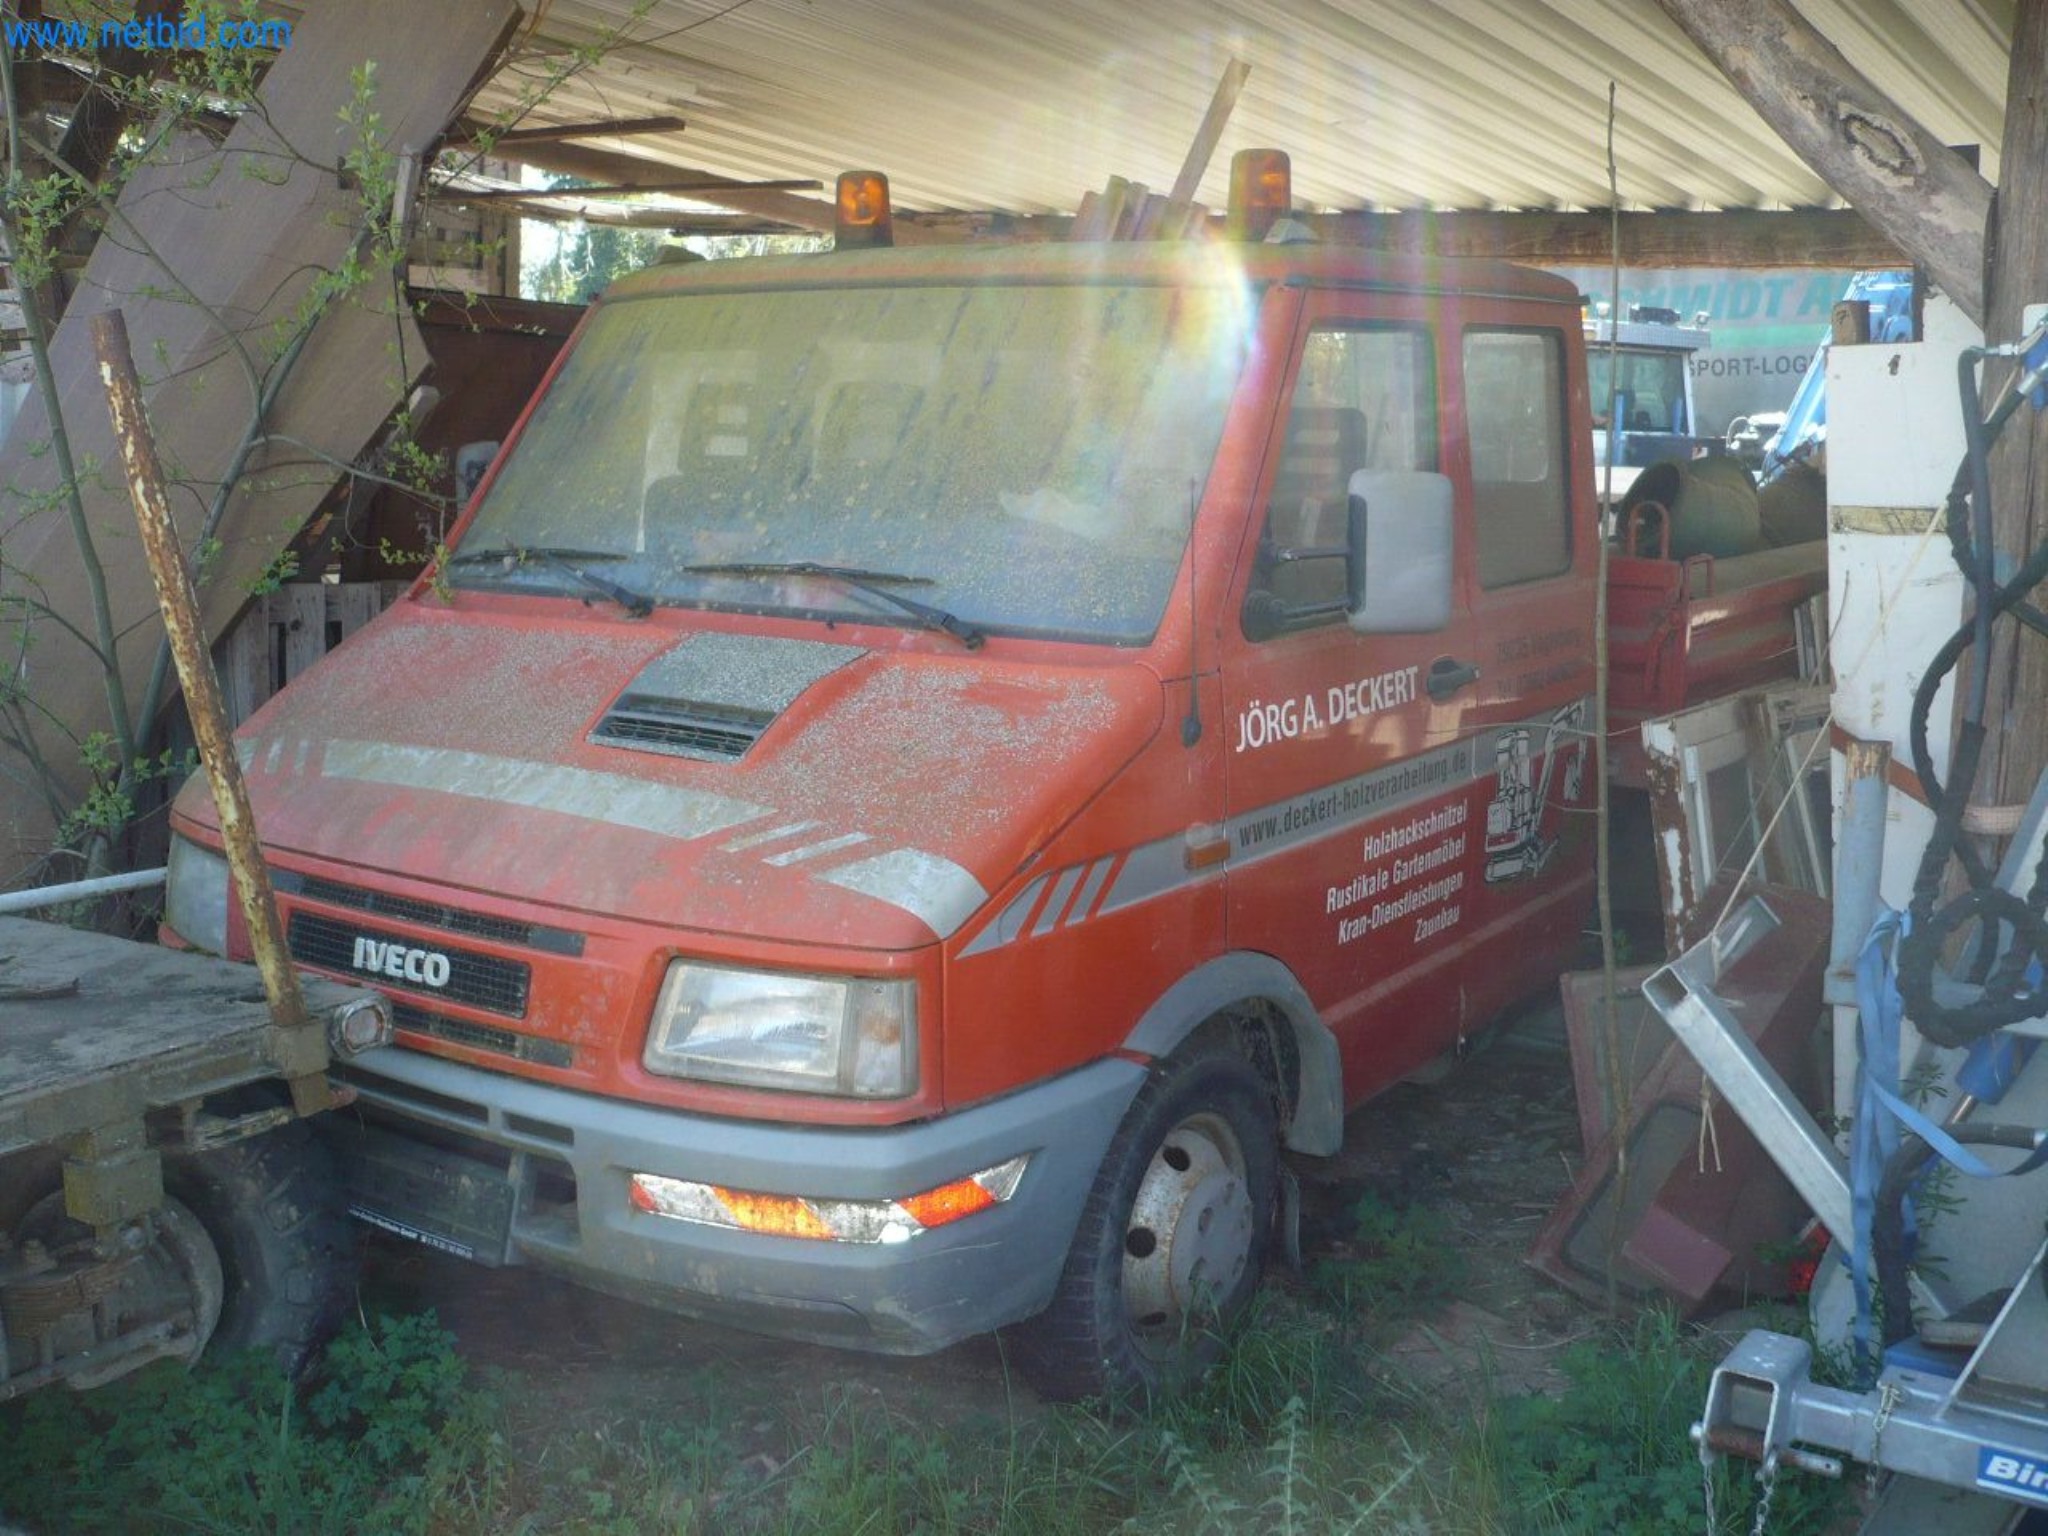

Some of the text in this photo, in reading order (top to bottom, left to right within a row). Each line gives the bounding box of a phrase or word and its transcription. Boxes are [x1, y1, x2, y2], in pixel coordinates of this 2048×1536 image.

[1235, 665, 1419, 753] JÖRG A. DECKERT
[1238, 752, 1467, 848] www.deckert-holzverarbeitung.de
[1363, 799, 1468, 862] Holzhackschnitzel
[1326, 832, 1466, 914] Rustikale Gartenmöbel
[1337, 870, 1463, 946] Kran-Dienstleistungen
[1413, 905, 1460, 943] Zaunbau
[352, 937, 450, 988] IVECO
